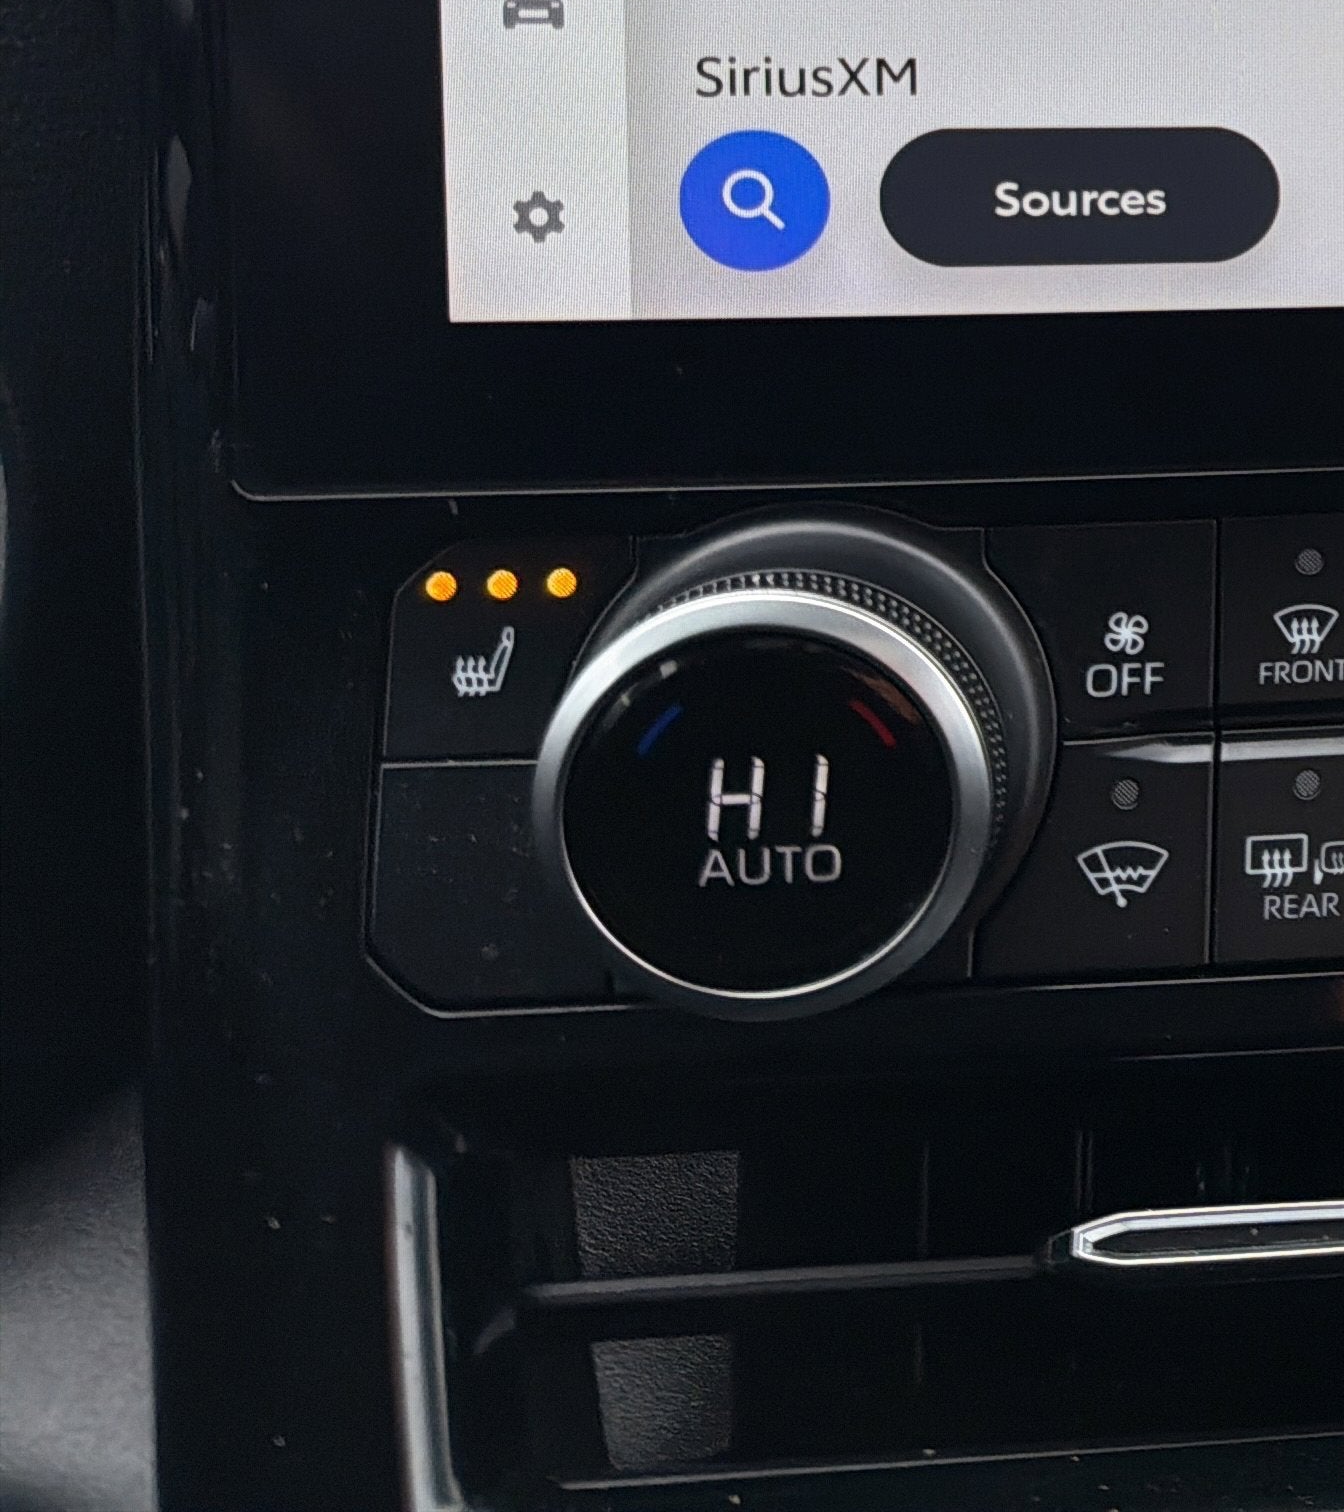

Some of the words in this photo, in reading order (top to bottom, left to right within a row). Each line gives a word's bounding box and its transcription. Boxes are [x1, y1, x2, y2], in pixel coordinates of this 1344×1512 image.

[697, 57, 916, 97] SiriusXM
[995, 182, 1166, 217] Sources
[1086, 662, 1163, 697] OFF
[708, 755, 828, 840] HI
[700, 845, 841, 886] AUTO
[1264, 893, 1339, 919] REAR
